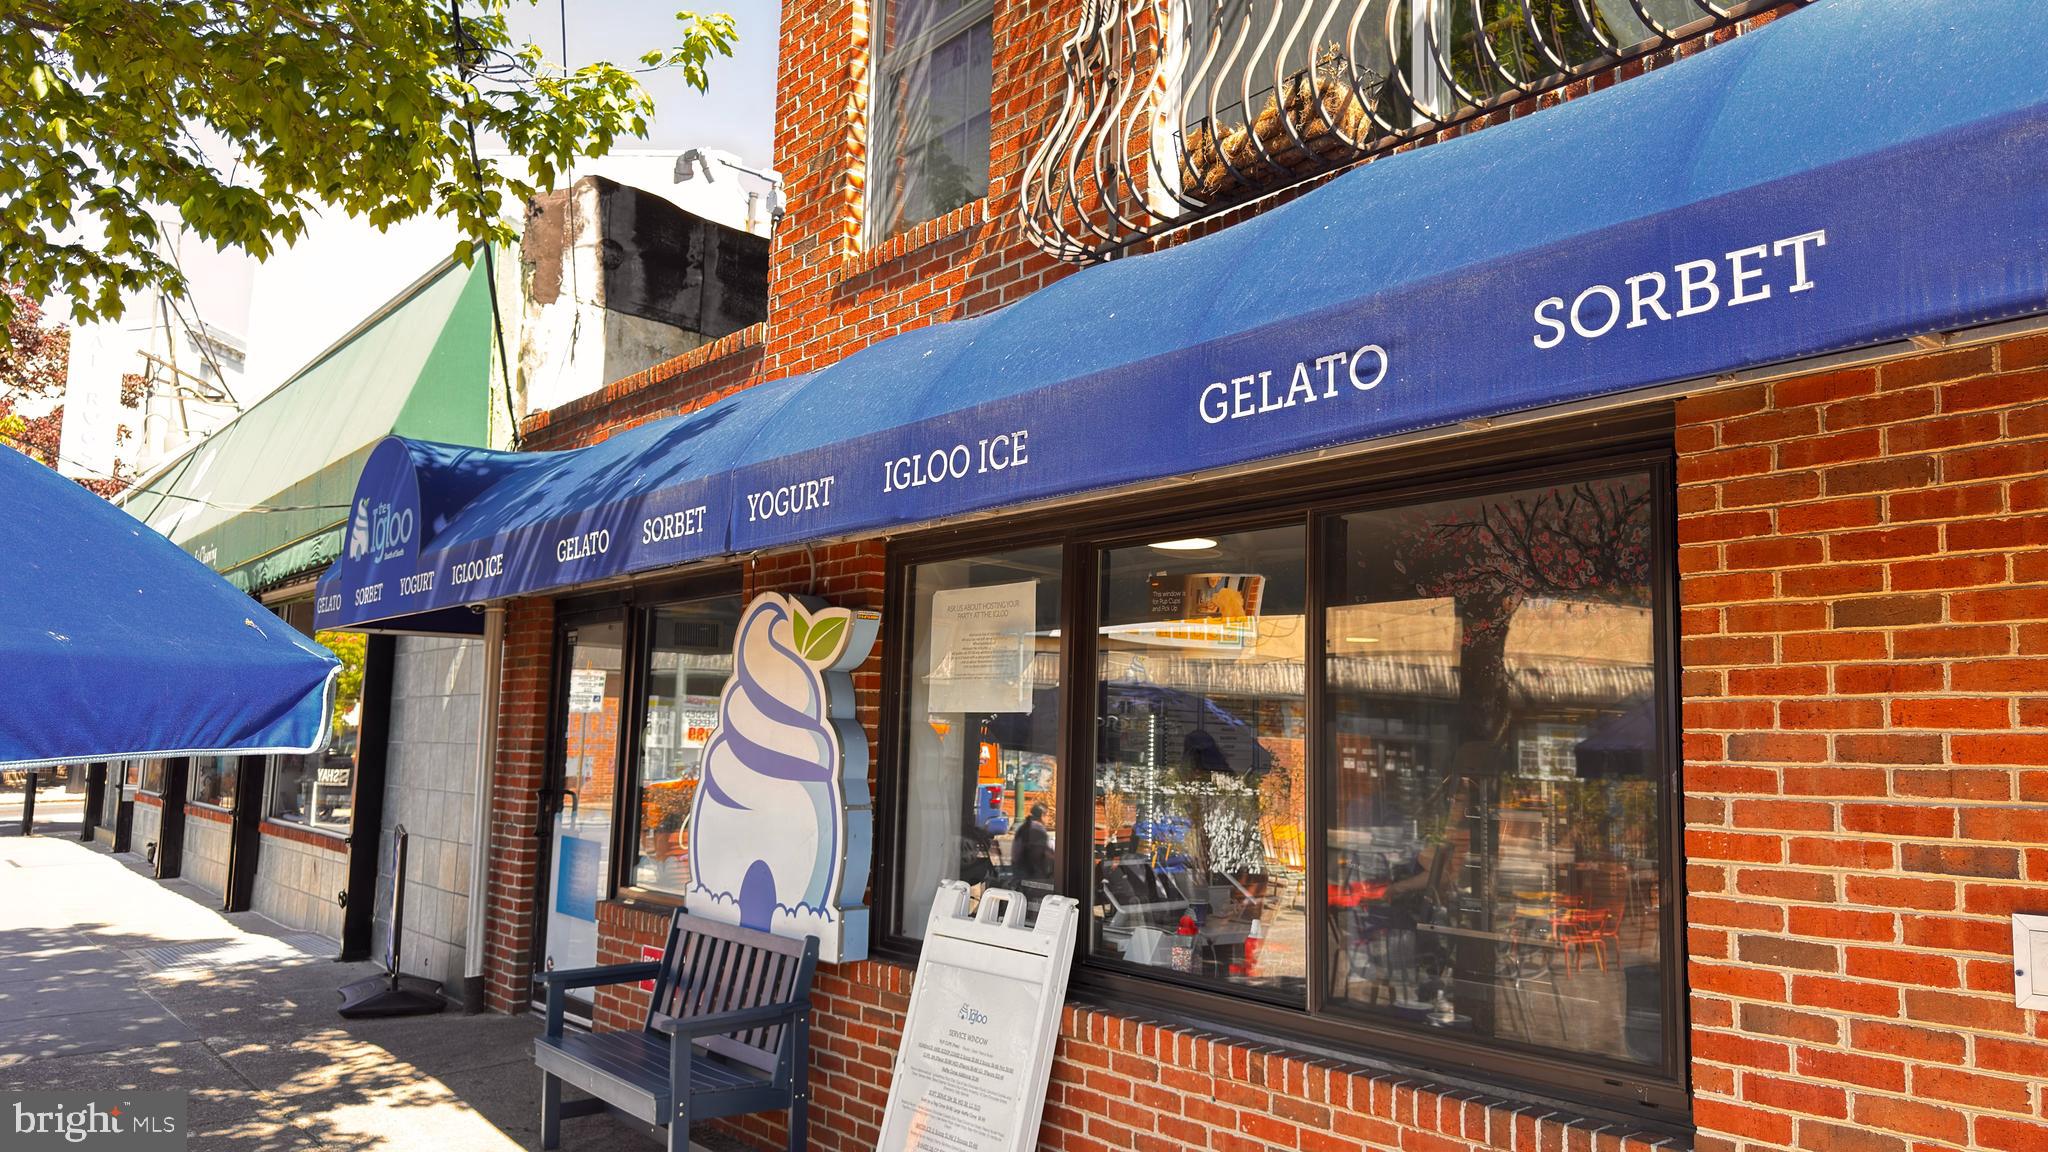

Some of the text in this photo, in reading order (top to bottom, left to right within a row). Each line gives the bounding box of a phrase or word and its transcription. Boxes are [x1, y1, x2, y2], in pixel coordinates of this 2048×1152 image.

[1533, 229, 1826, 349] SORBET
[1199, 343, 1388, 425] GELATO
[884, 430, 1029, 494] IGLOO ICE
[747, 475, 835, 522] YOGURT
[370, 503, 414, 564] Igloo
[642, 505, 707, 545] SORBET
[556, 529, 610, 564] GELATO
[400, 571, 435, 596] YOGURT
[452, 554, 504, 586] IGLOO ICE
[317, 593, 342, 614] GELATO
[355, 583, 384, 606] SORBET
[968, 1008, 988, 1025] Igloo
[949, 1029, 989, 1045] SERVICE WINDOW
